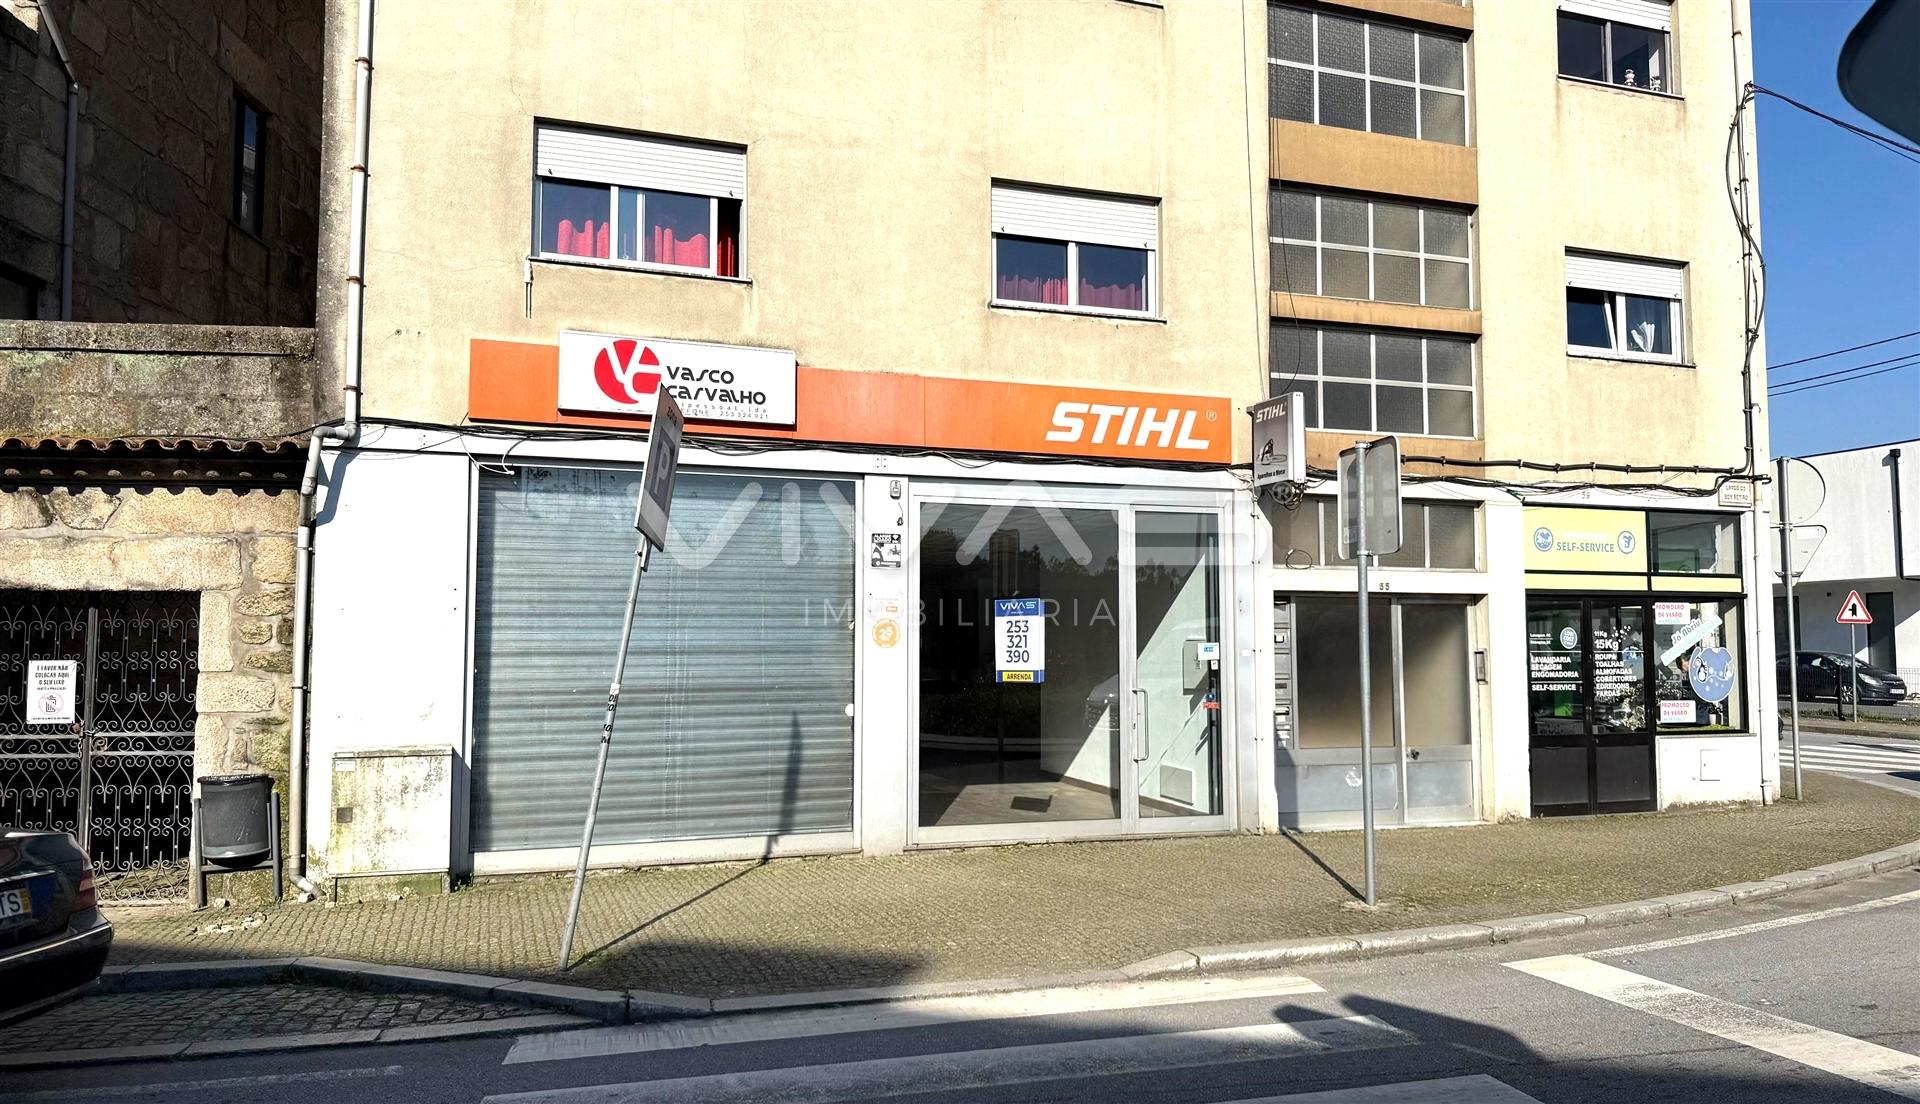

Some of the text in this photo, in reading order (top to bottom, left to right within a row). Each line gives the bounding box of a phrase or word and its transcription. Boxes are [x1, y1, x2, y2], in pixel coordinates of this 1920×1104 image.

[1255, 403, 1286, 424] STIHL
[1045, 401, 1210, 450] STIHL
[1556, 542, 1615, 553] SELF-SERVICE
[1000, 601, 1037, 610] VIVAS
[1006, 620, 1029, 633] 253
[1007, 634, 1028, 648] 321
[1594, 639, 1619, 651] 15Kg
[1006, 650, 1030, 663] 390
